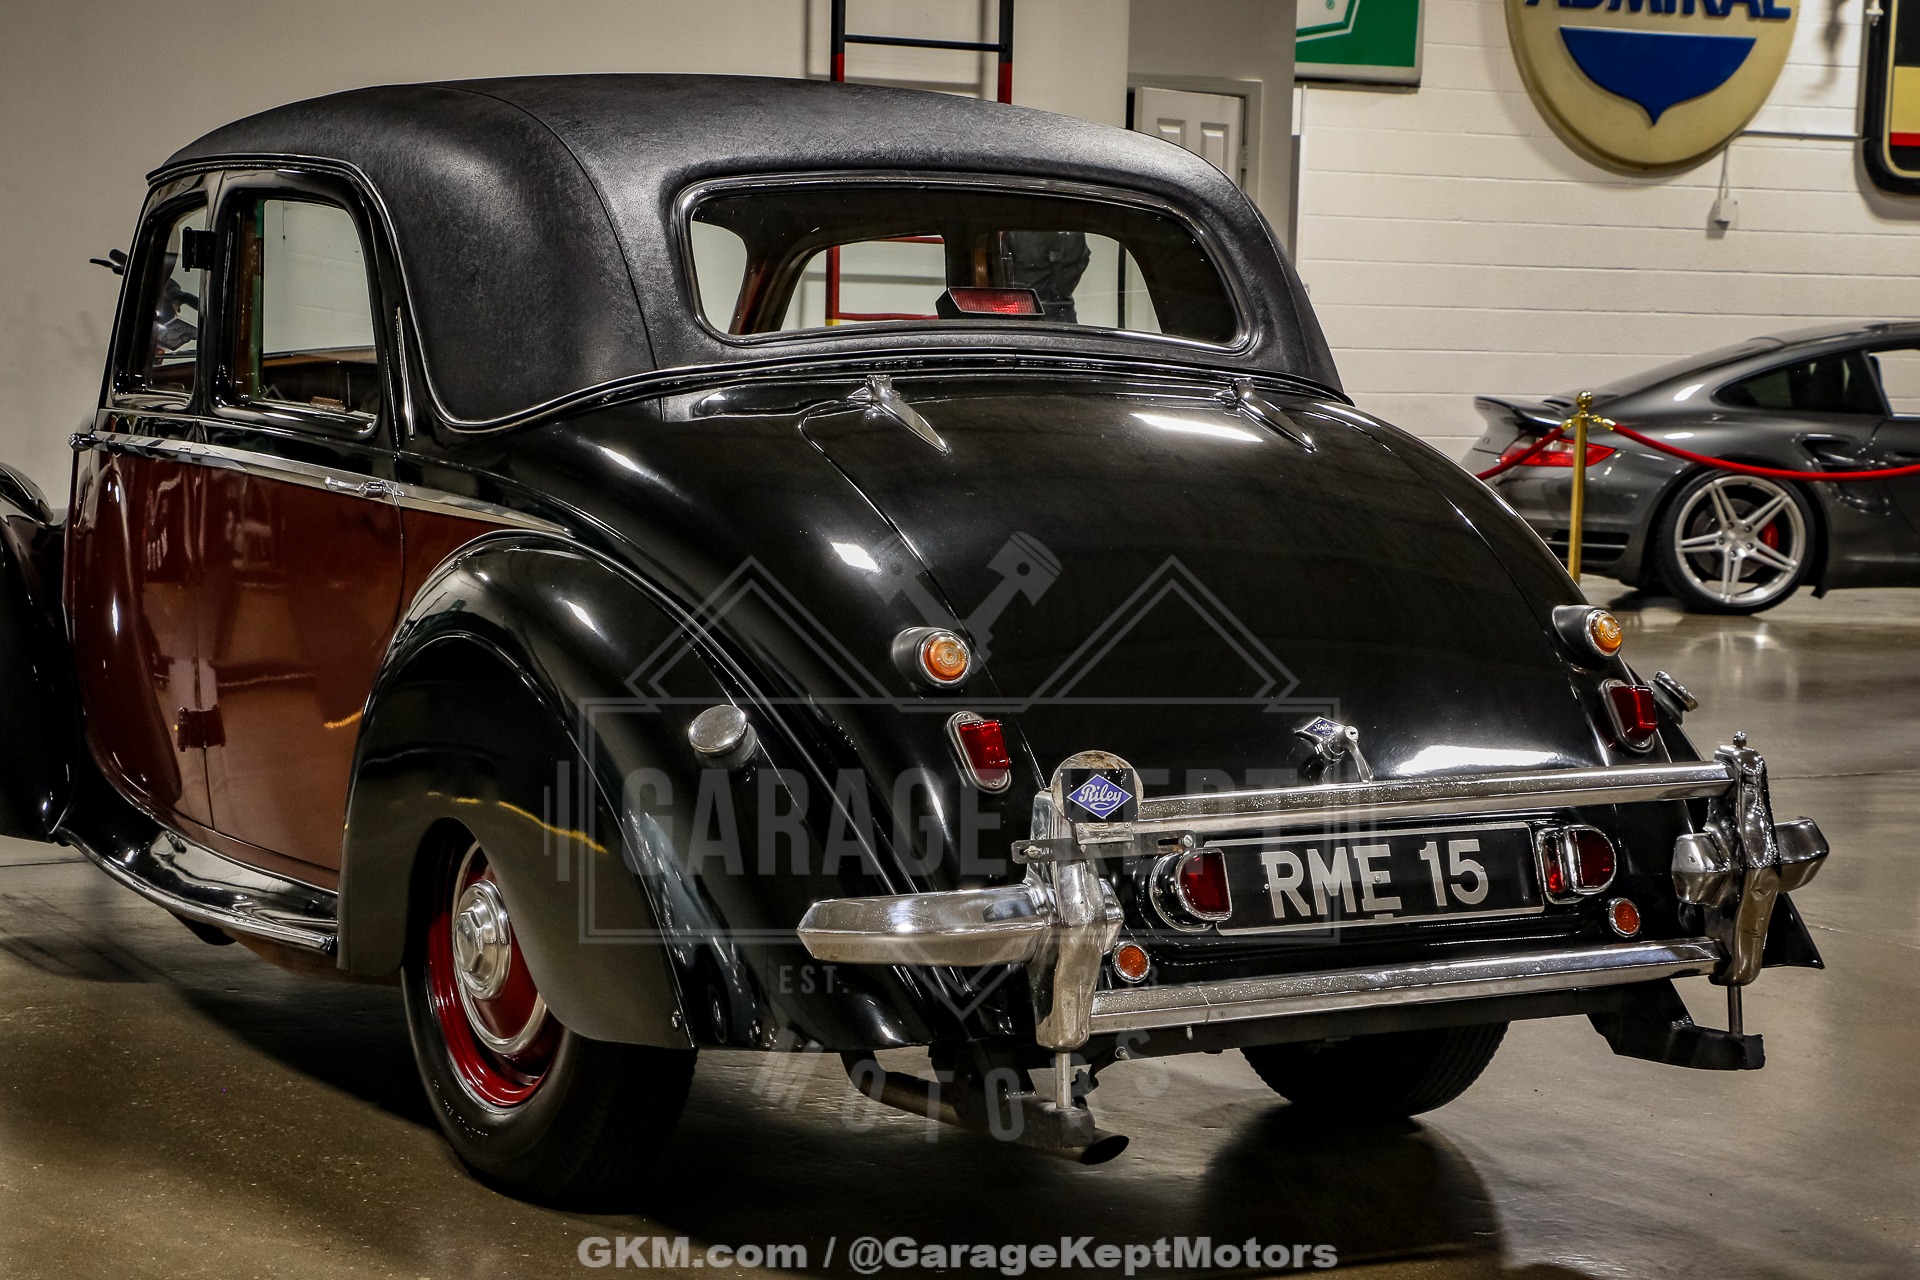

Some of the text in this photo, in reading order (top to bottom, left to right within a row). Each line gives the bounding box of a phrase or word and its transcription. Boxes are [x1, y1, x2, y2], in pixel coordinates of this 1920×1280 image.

[1079, 784, 1122, 810] Riley
[1261, 839, 1489, 918] RME 15
